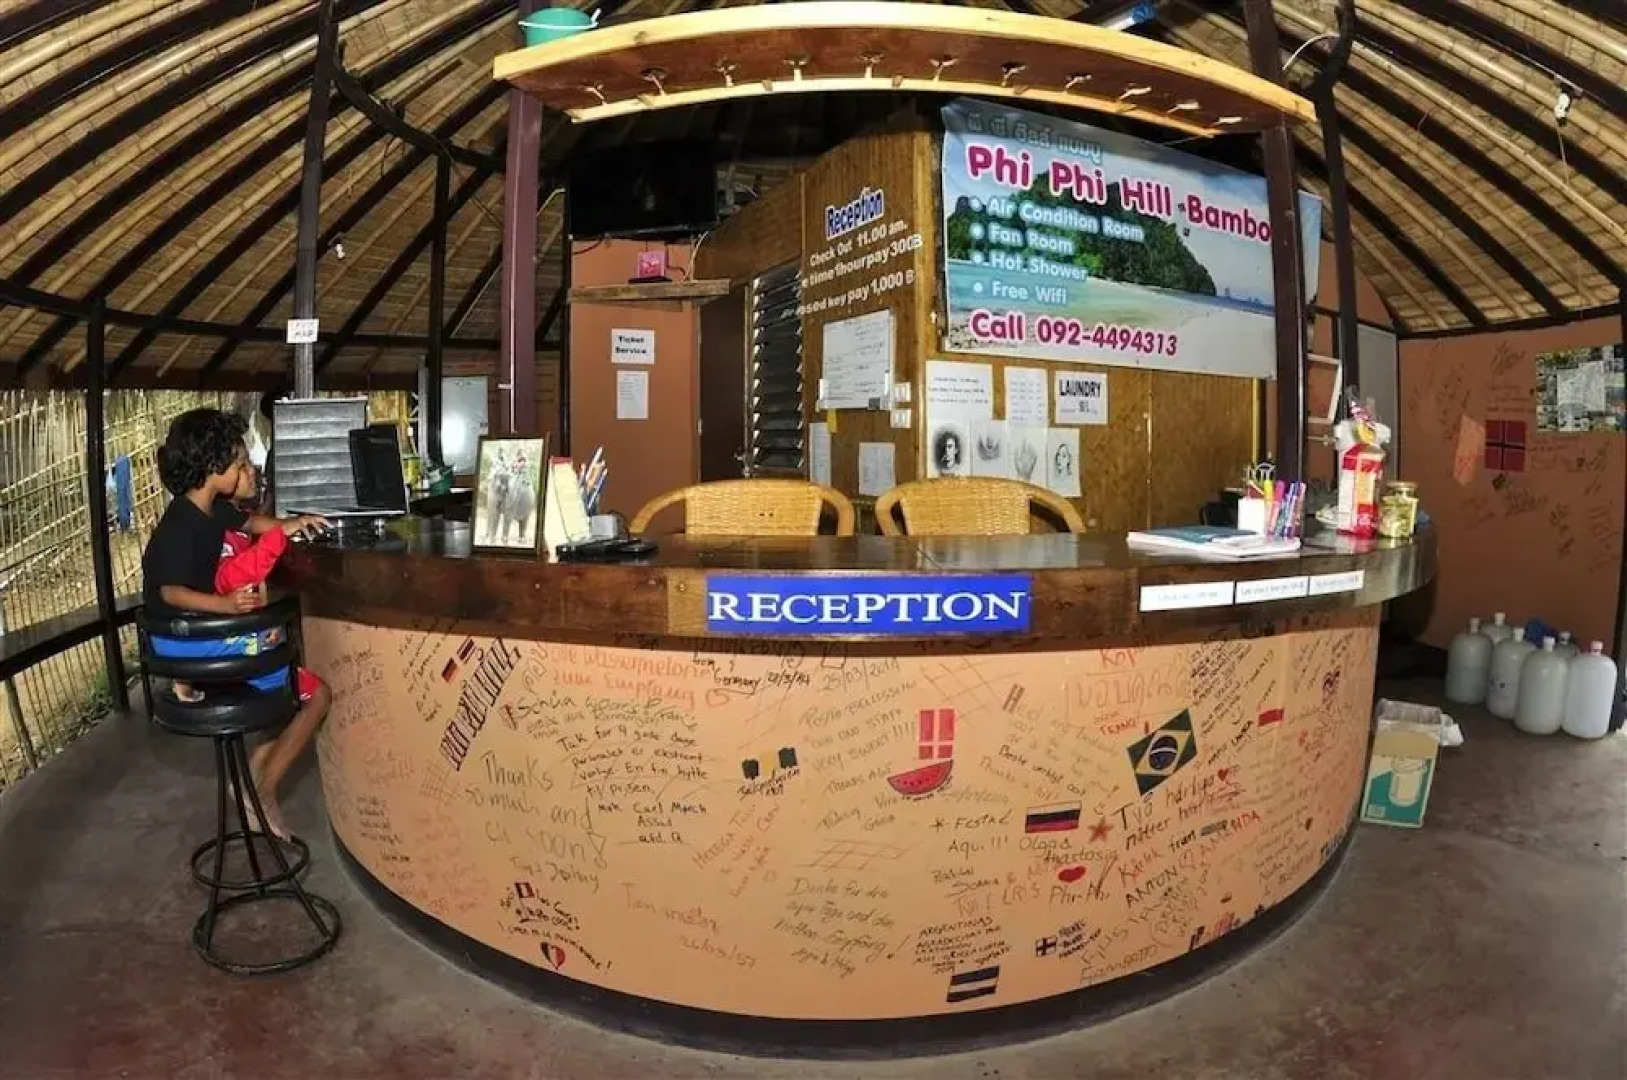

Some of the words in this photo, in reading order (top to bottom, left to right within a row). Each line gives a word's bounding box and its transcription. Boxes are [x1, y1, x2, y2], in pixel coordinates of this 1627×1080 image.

[967, 146, 1031, 189] Phi
[1050, 161, 1105, 202] Phi
[1119, 177, 1172, 217] Hill
[827, 187, 884, 240] Reception
[987, 198, 1015, 217] Air
[1020, 202, 1099, 232] Condition
[1103, 217, 1145, 241] Room
[810, 247, 835, 267] Check
[837, 239, 853, 256] Out
[857, 224, 887, 247] 11.00
[989, 227, 1024, 247] Fan
[1027, 232, 1074, 254] Room
[810, 269, 834, 286] time
[1029, 255, 1088, 281] Shower
[847, 283, 870, 304] pay
[870, 271, 904, 296] 1,000
[992, 280, 1028, 300] Free
[1035, 285, 1068, 305] Wifi
[971, 312, 1025, 340] Call
[1037, 321, 1178, 357] 092-4494313
[1058, 378, 1101, 398] LAUNDRY
[708, 591, 1026, 624] RECEPTION
